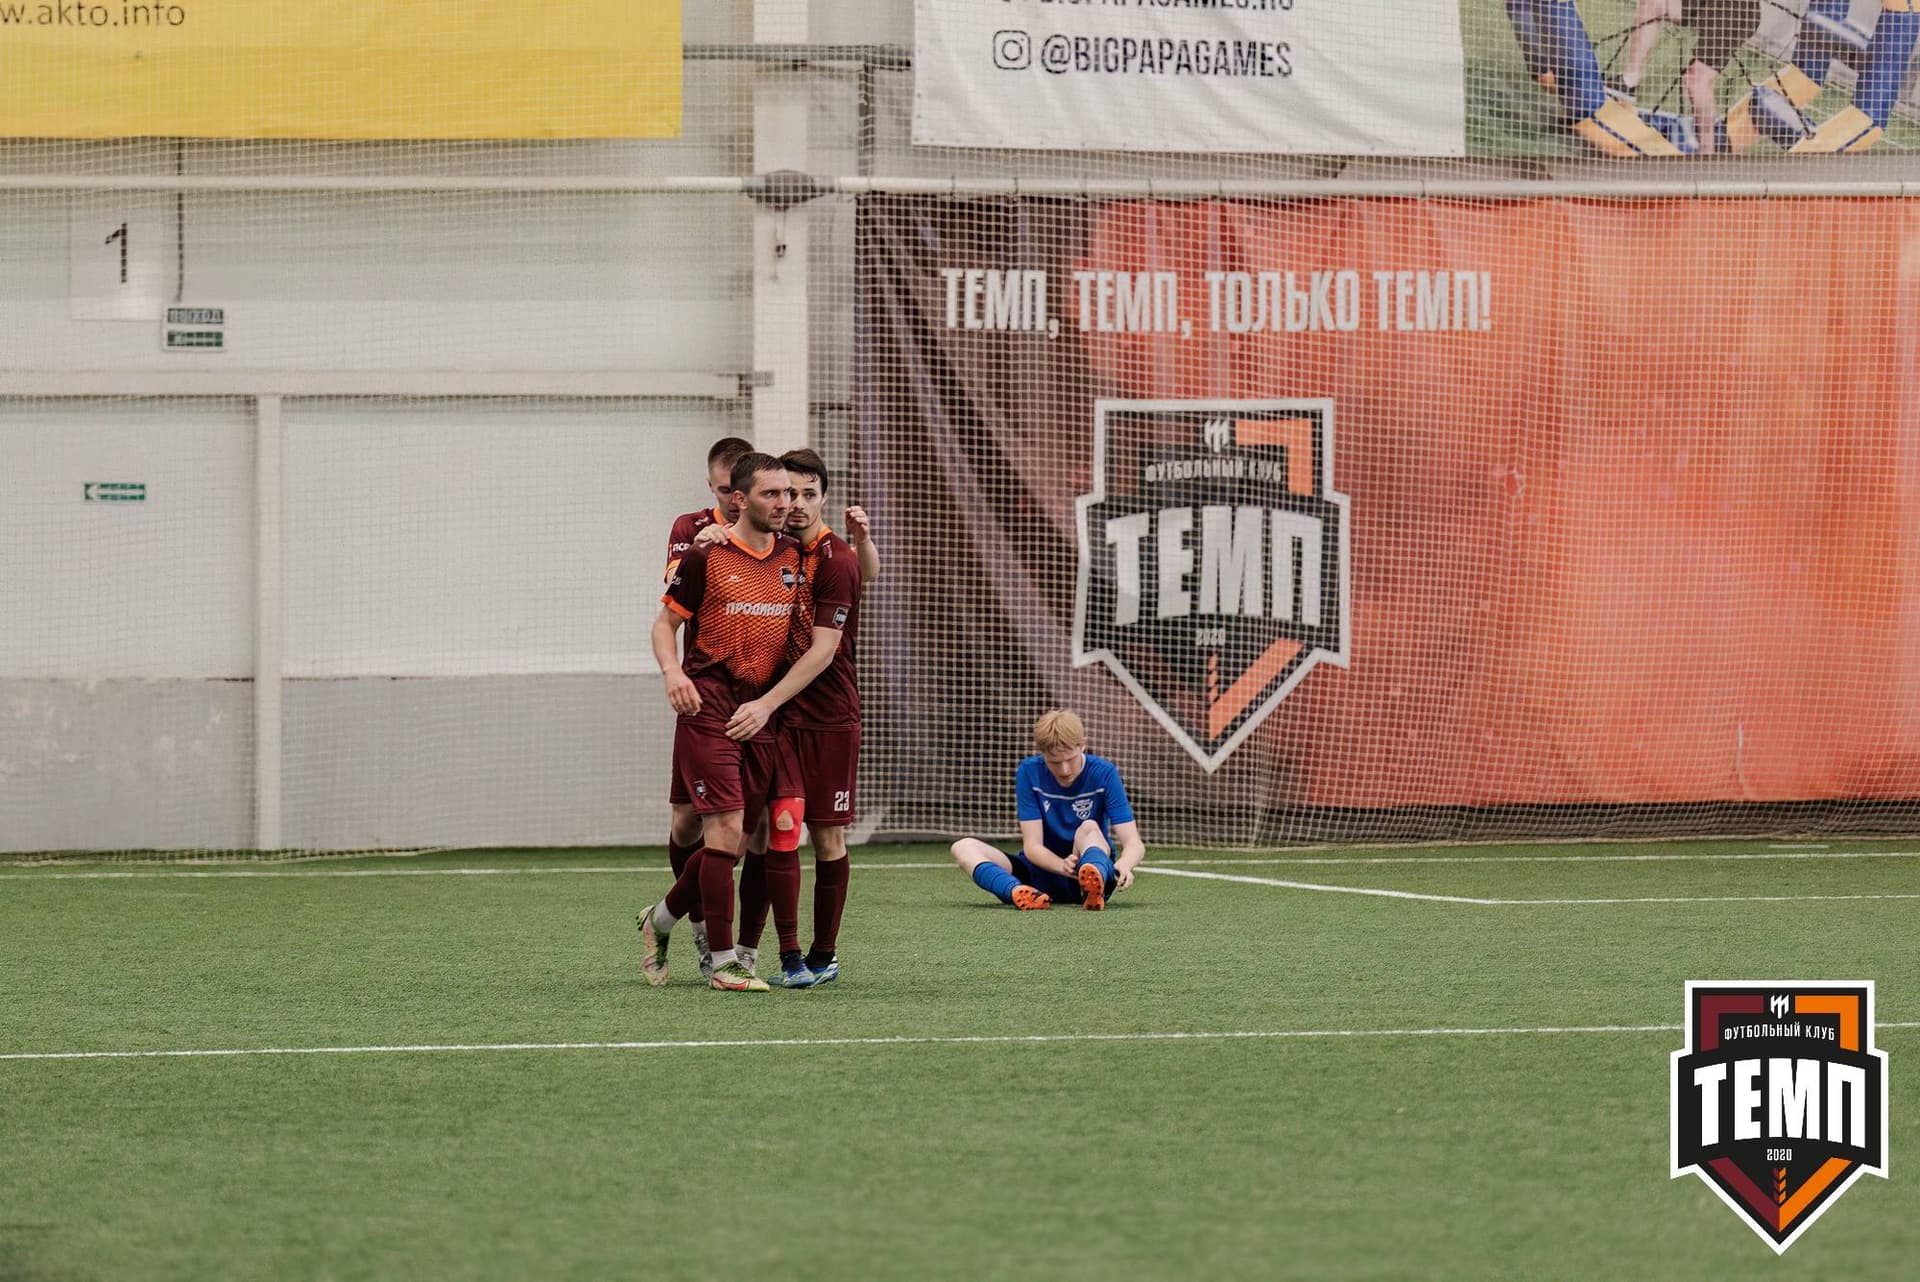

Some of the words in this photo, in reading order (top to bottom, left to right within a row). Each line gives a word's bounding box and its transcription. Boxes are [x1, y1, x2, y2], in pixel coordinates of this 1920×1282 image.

[1041, 34, 1293, 77] @BIGPAPAGAMES
[105, 222, 128, 283] 1
[941, 268, 1060, 338] ТЕМП,
[1073, 271, 1191, 338] ТЕМП,
[1205, 271, 1360, 332] ТОЛЬКО
[1373, 271, 1491, 332] ТЕМП!
[1105, 505, 1324, 628] ТЕМП
[834, 790, 850, 812] 23
